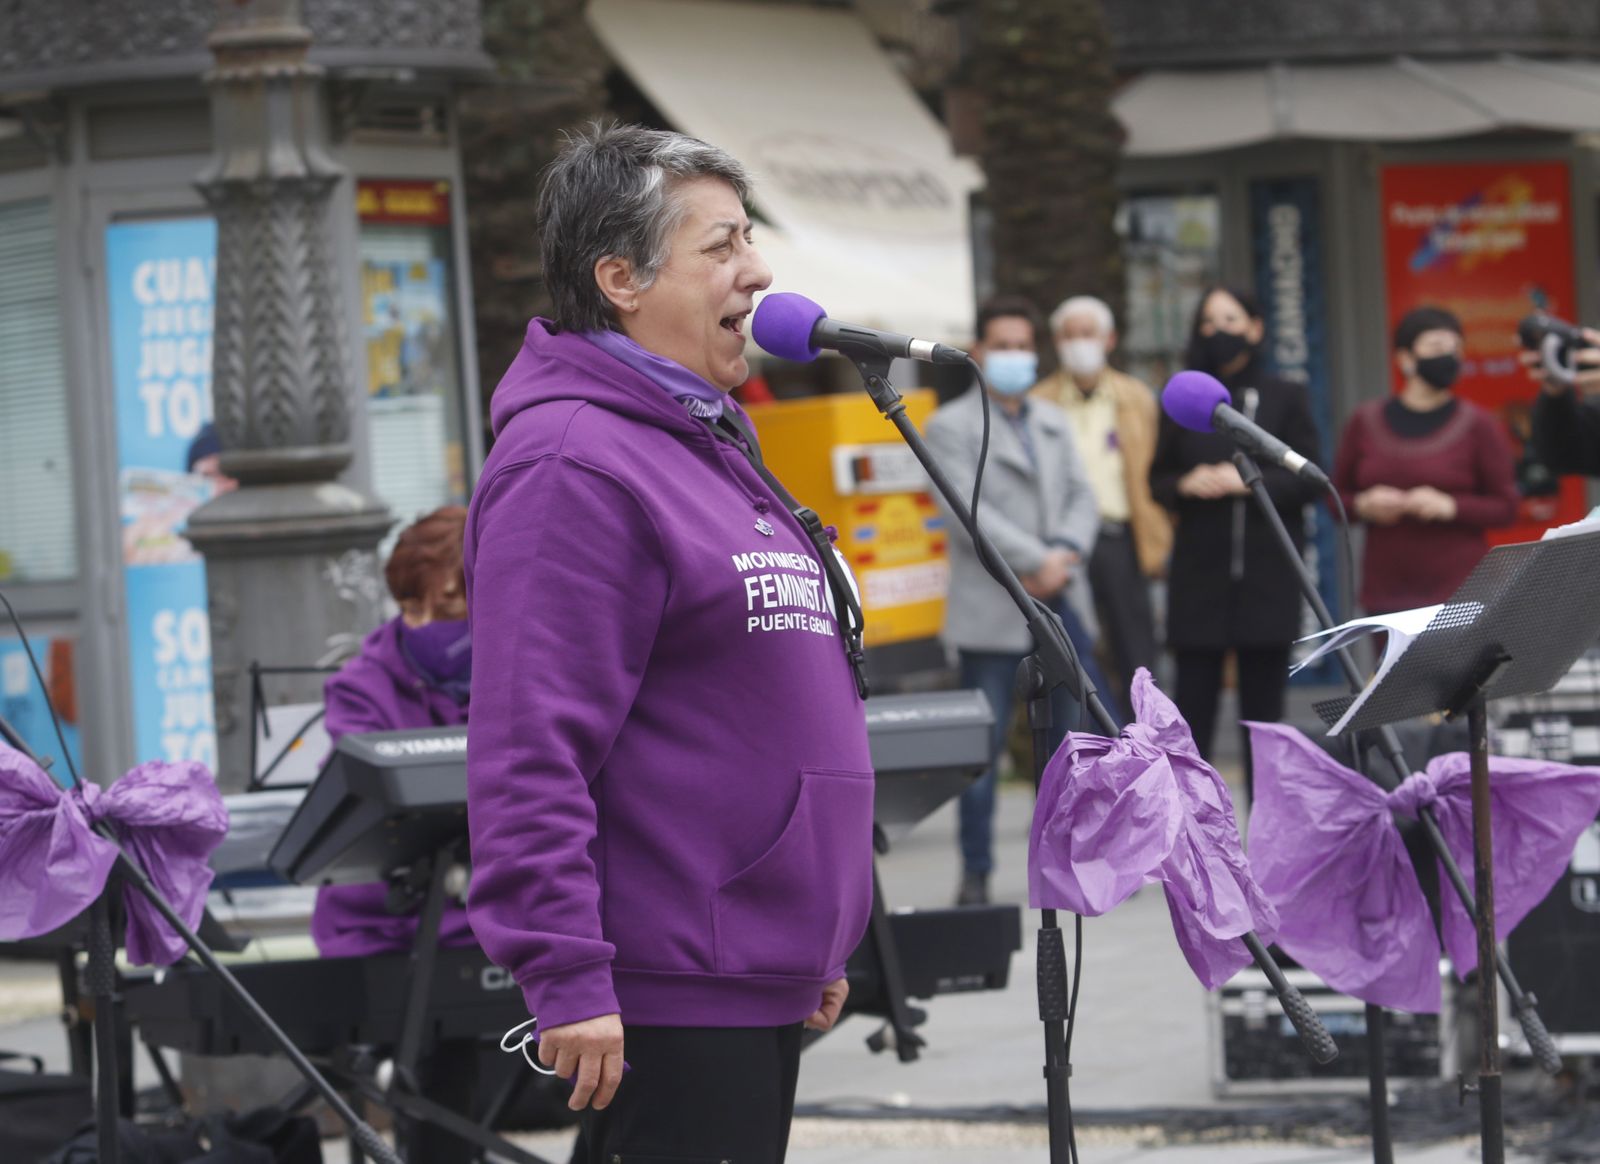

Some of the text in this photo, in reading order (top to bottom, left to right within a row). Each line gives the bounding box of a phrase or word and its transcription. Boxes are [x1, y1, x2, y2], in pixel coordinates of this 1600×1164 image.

[133, 256, 217, 304] CUA
[748, 613, 834, 636] PUENTE GENIL
